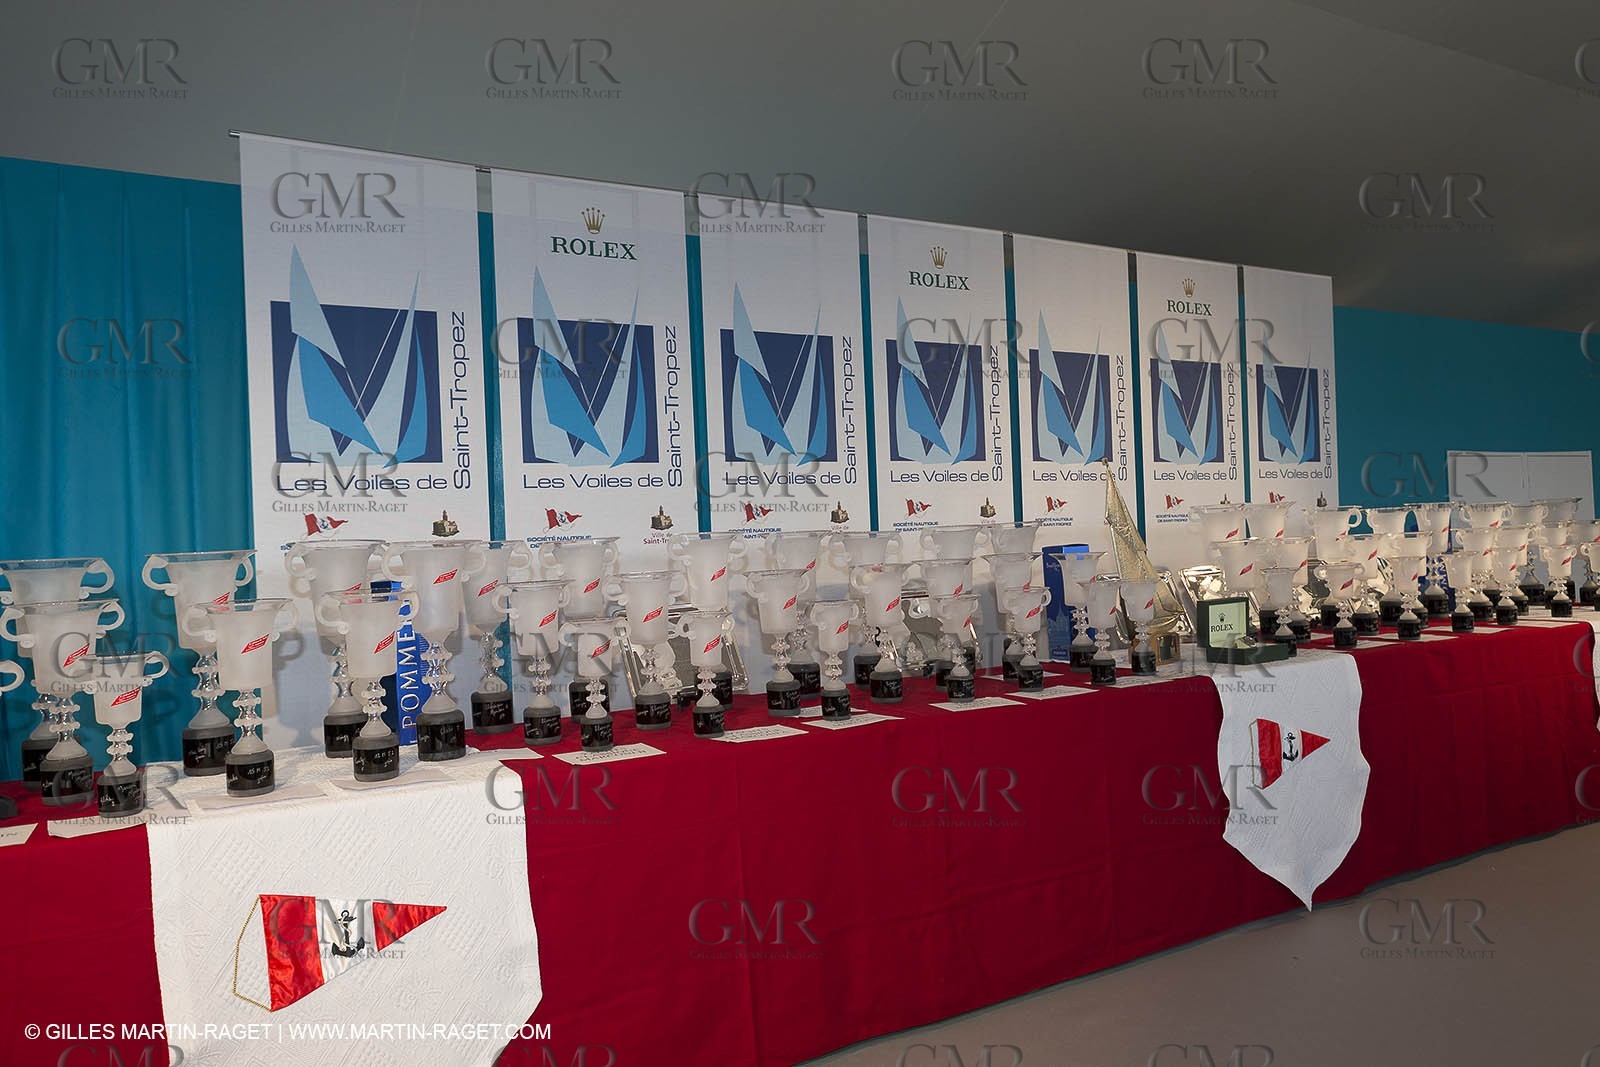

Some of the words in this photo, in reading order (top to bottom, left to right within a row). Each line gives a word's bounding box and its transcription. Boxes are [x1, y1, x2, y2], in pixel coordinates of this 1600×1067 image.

[550, 236, 638, 261] ROLEX
[908, 270, 971, 291] ROLEX
[1166, 299, 1213, 317] ROLEX
[449, 311, 471, 489] Saint-Tropez
[664, 325, 683, 487] Saint-Tropez
[841, 336, 857, 484] Saint-Tropez
[989, 345, 1003, 481] Saint-Tropez
[1115, 355, 1128, 481] Saint-Tropez
[1322, 368, 1332, 479] Saint-Tropez
[277, 475, 327, 491] Les
[333, 474, 410, 491] Voiles
[416, 474, 448, 489] de
[523, 474, 565, 489] Les
[570, 473, 633, 488] Voiles
[638, 473, 664, 487] de
[725, 471, 760, 486] Les
[763, 471, 816, 485] Voiles
[820, 471, 841, 484] de
[890, 470, 920, 483] Les
[923, 470, 968, 482] Voiles
[970, 469, 989, 482] de
[1032, 470, 1058, 481] Les
[1059, 470, 1099, 481] Voiles
[1153, 469, 1176, 481] Les
[1177, 469, 1211, 481] Voiles
[1212, 469, 1227, 481] de
[1258, 468, 1278, 479] Les
[1280, 468, 1309, 479] Voiles
[1310, 468, 1323, 479] de
[643, 537, 670, 545] Saint-Tr
[1210, 623, 1234, 633] ROLEX
[397, 610, 420, 730] POMME
